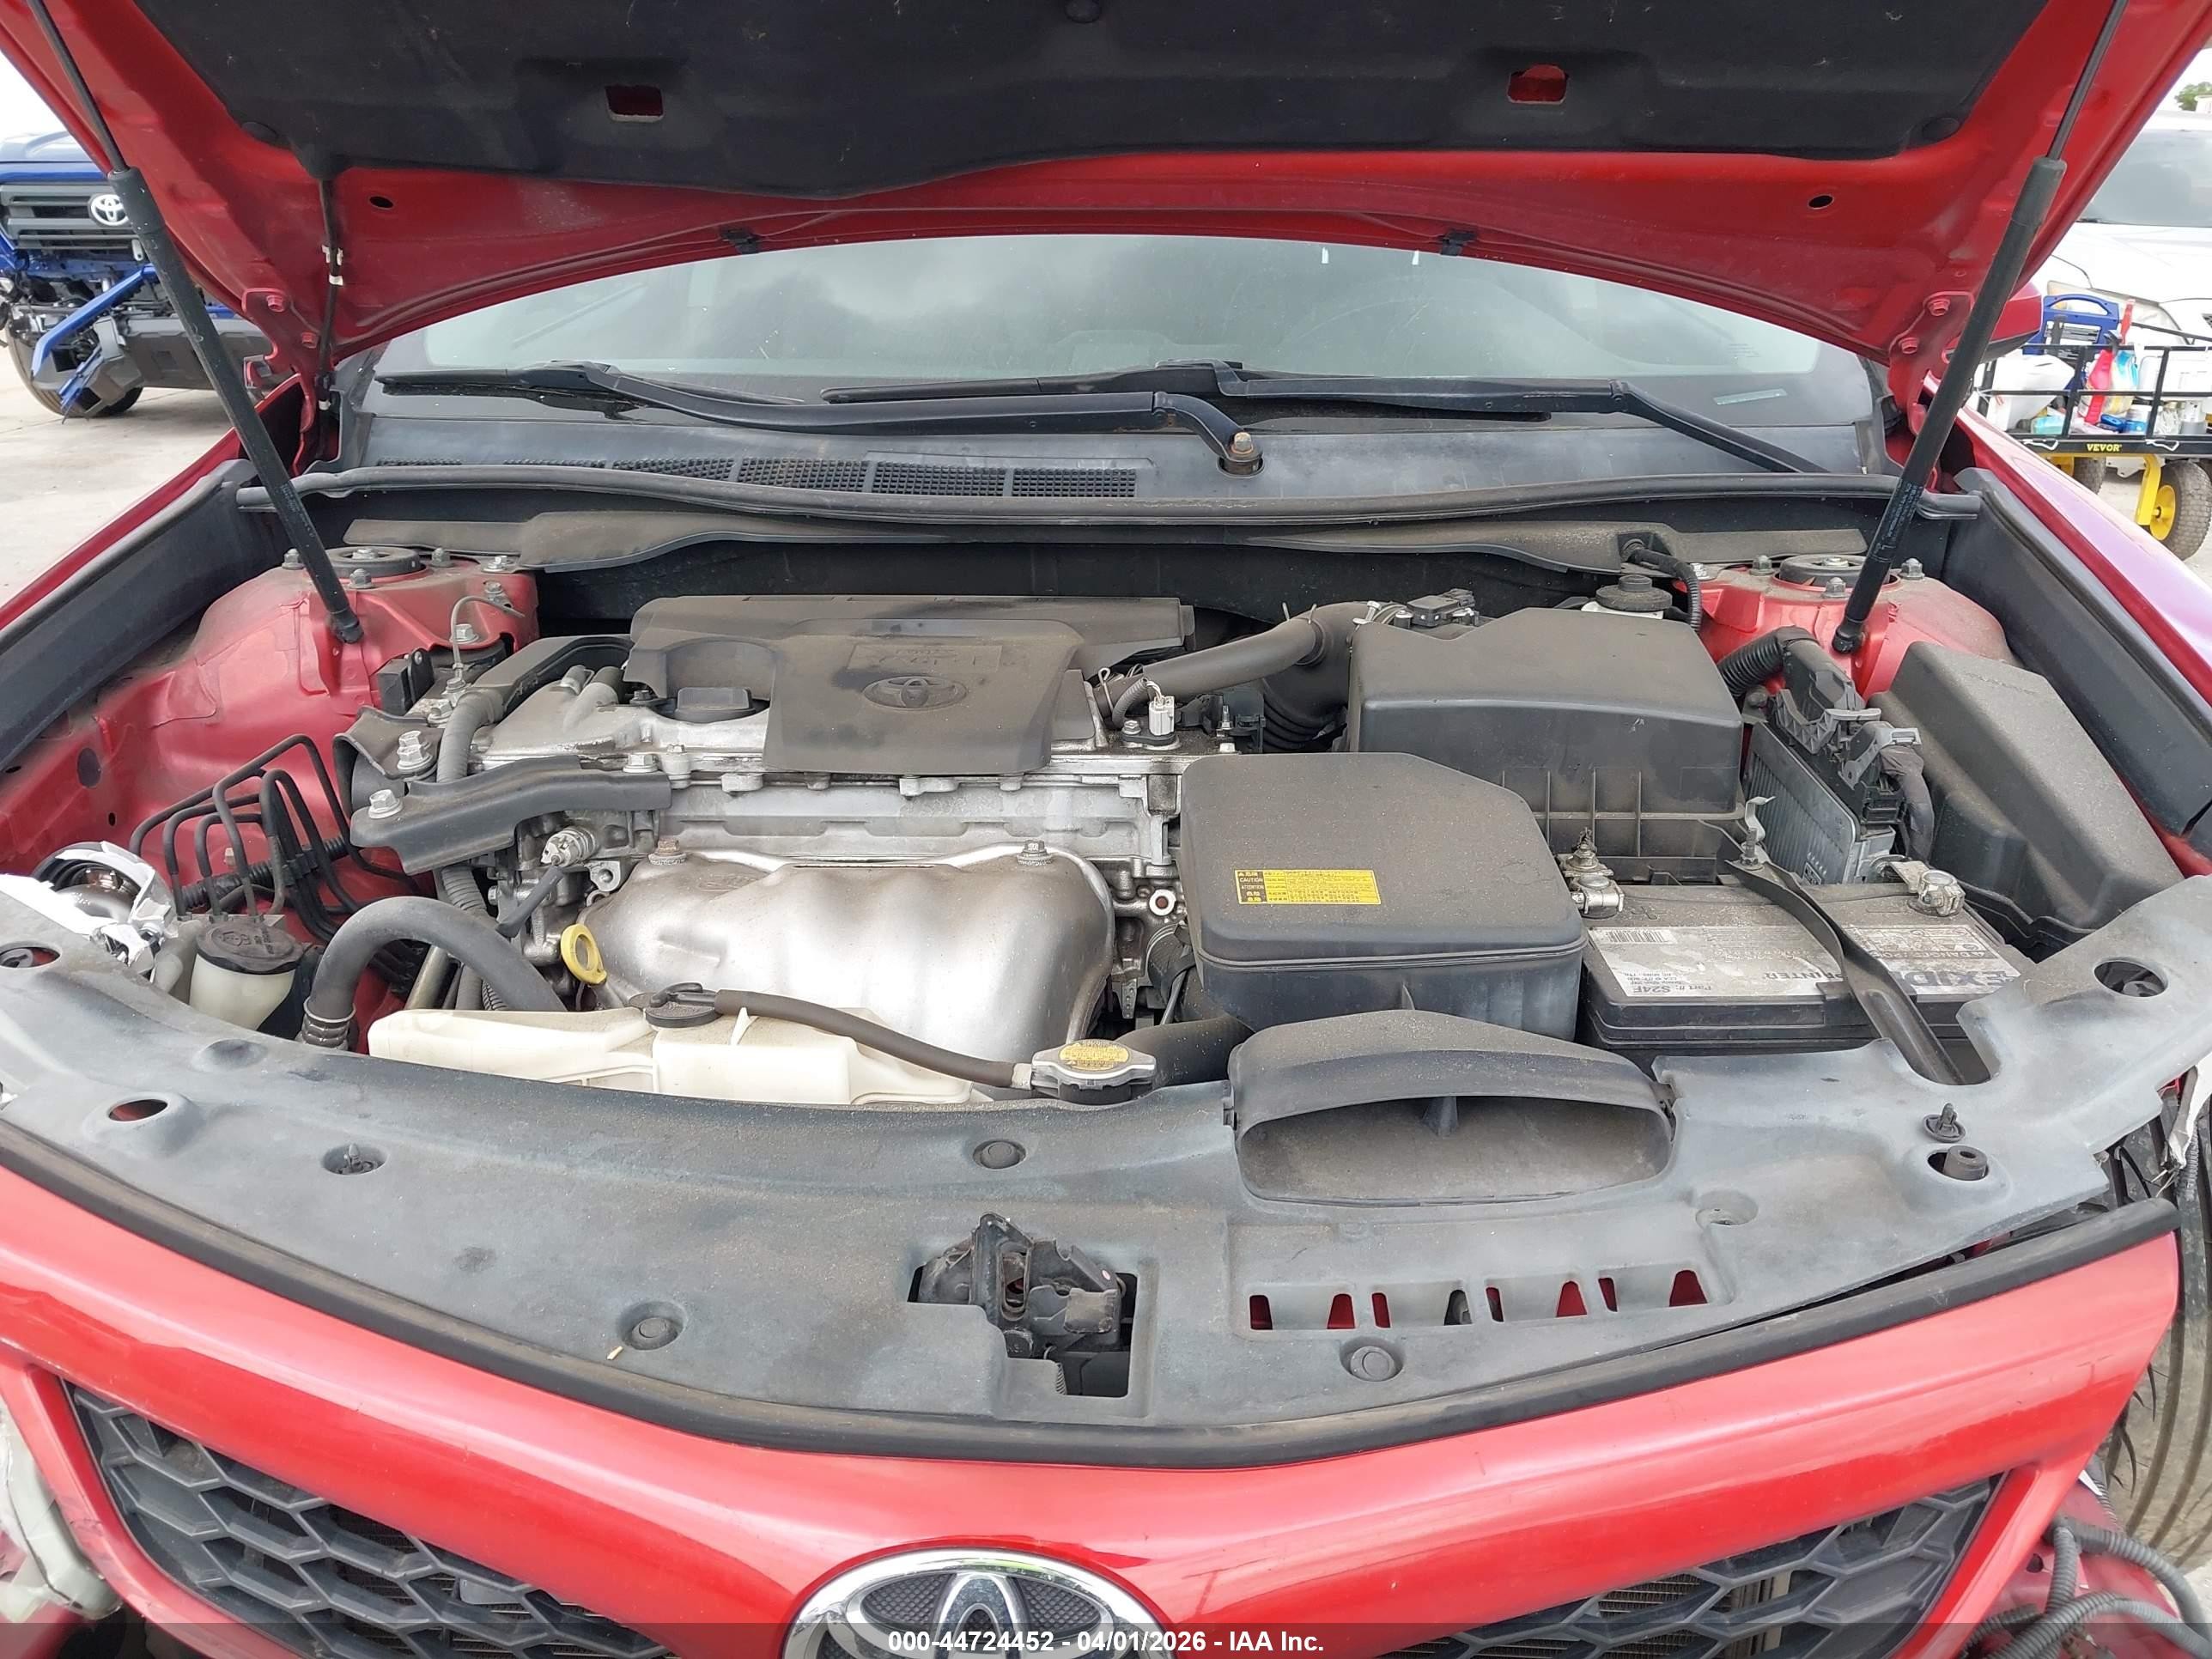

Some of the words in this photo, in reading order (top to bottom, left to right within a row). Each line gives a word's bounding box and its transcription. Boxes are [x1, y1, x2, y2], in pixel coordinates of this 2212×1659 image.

[1765, 971, 1846, 981] PRINTER
[1892, 971, 2011, 986] EXID
[1632, 985, 1671, 994] S24F
